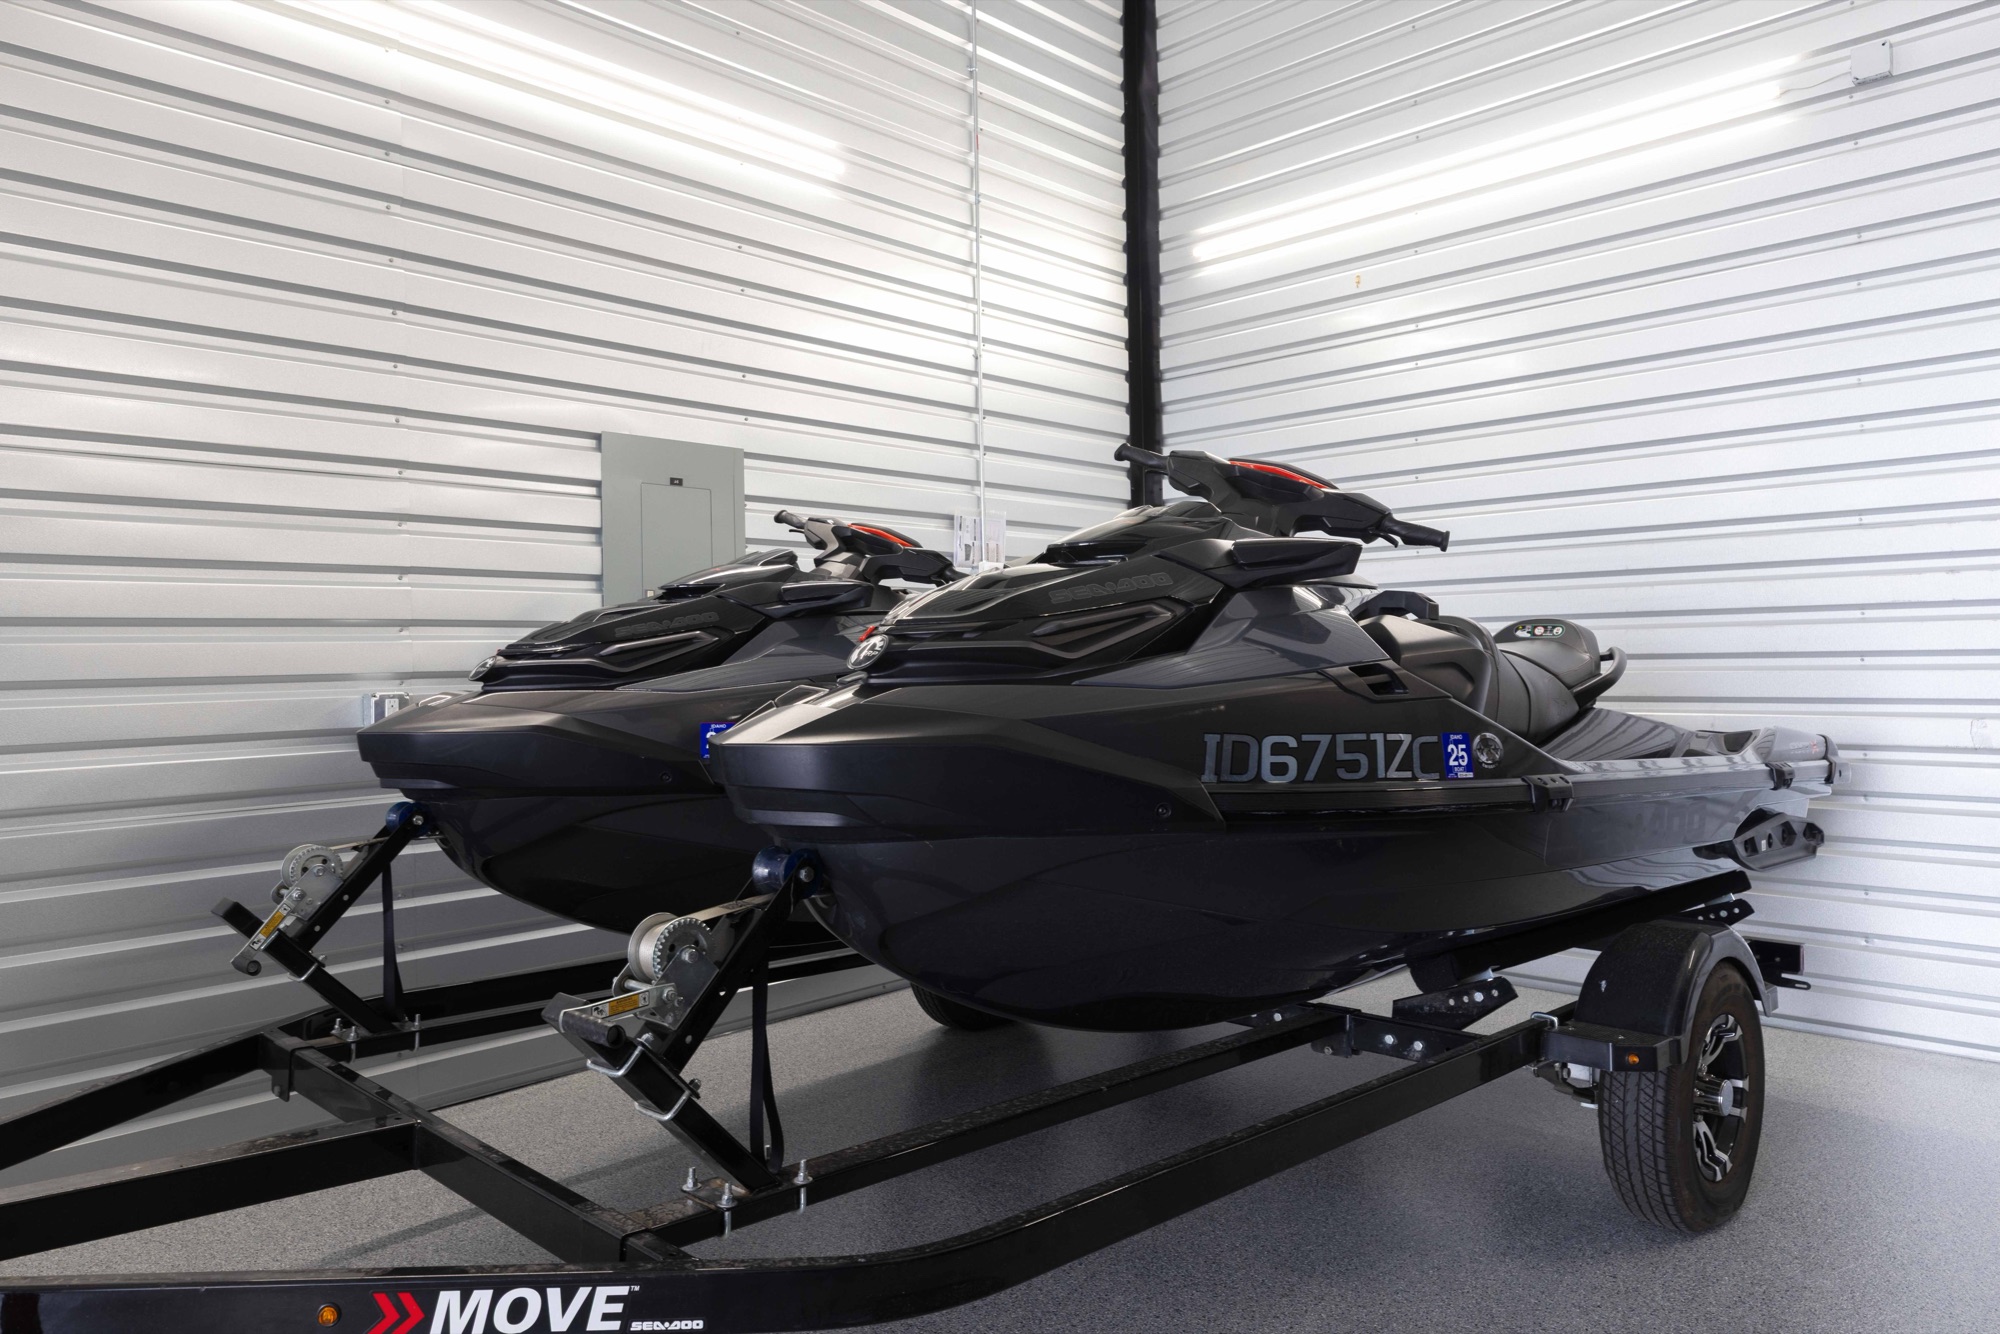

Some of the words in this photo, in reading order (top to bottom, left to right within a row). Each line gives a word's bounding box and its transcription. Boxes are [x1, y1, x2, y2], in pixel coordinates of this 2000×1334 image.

[1201, 733, 1440, 783] ID6751ZC
[1447, 744, 1468, 766] 25
[429, 1286, 630, 1334] MOVE
